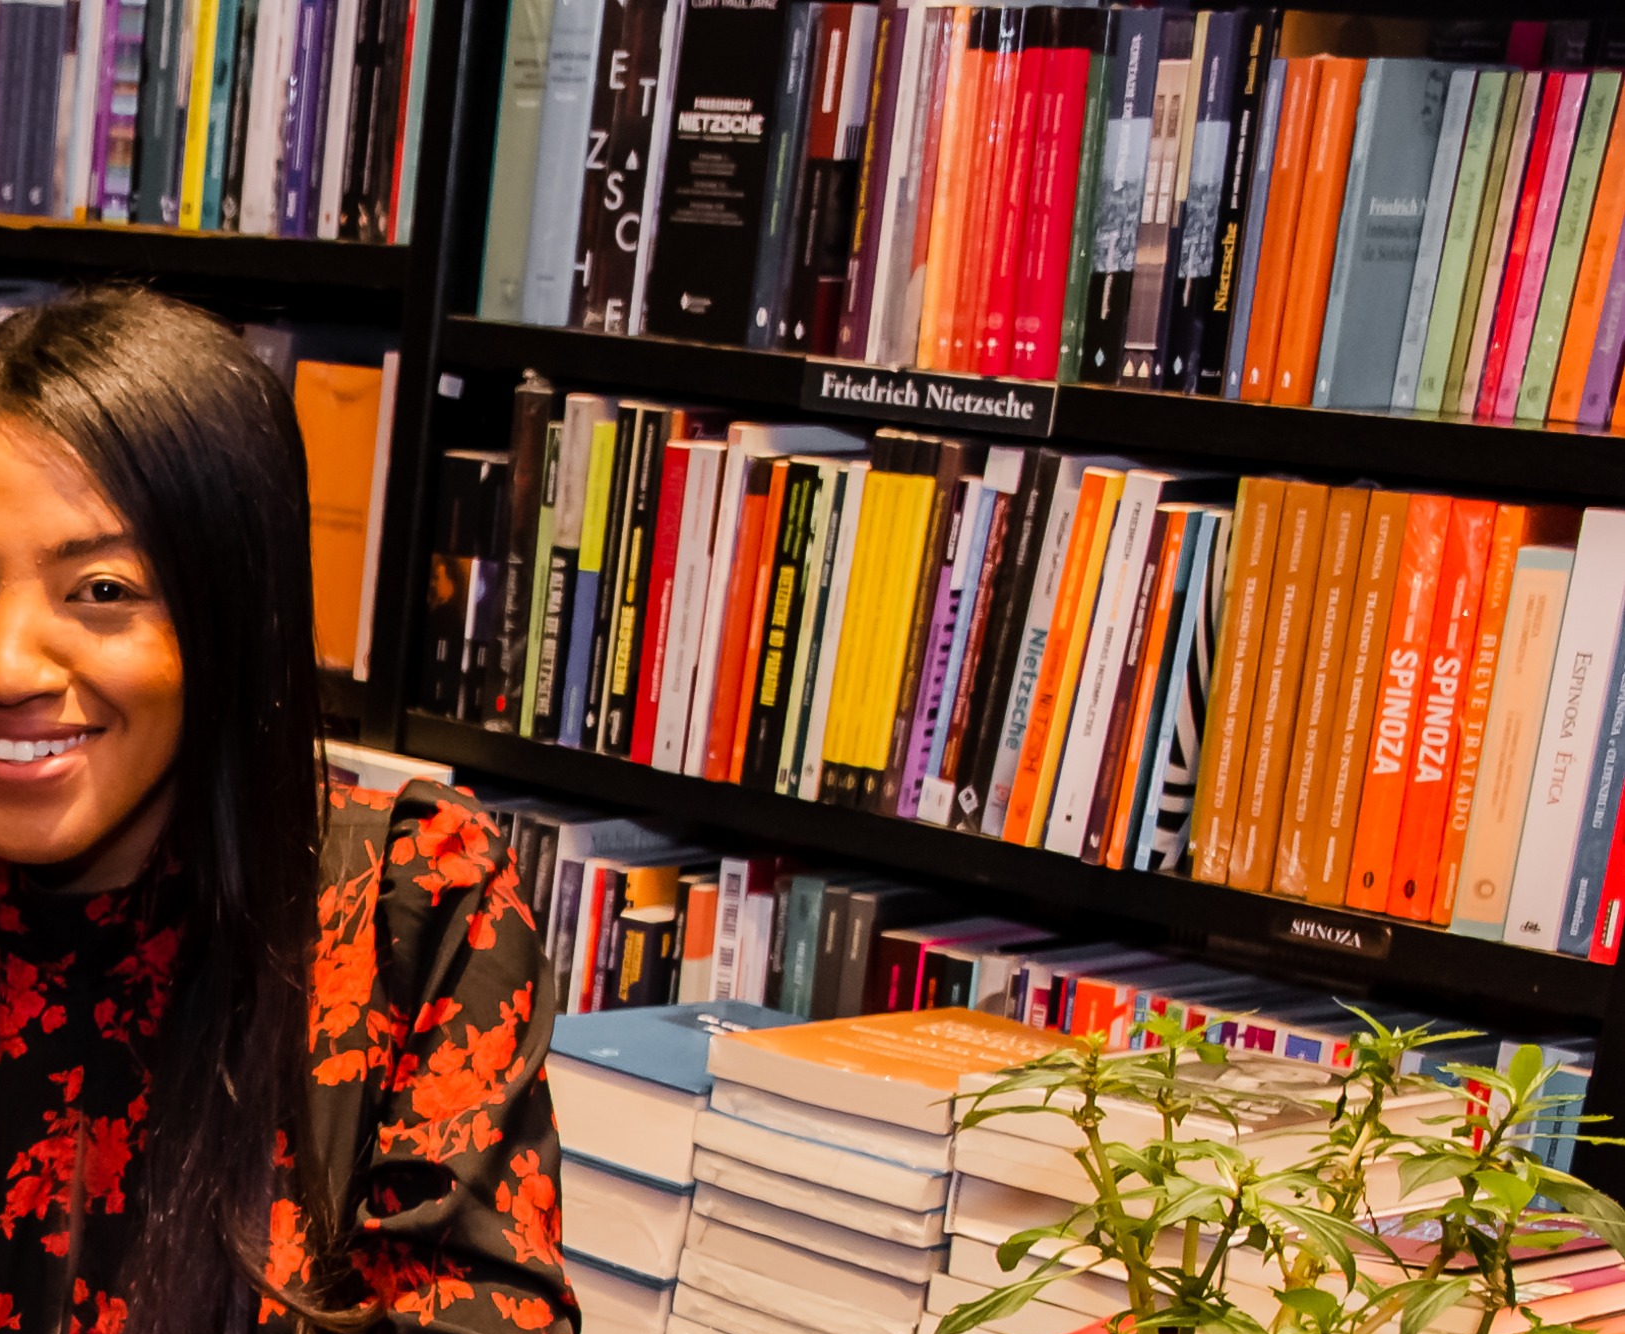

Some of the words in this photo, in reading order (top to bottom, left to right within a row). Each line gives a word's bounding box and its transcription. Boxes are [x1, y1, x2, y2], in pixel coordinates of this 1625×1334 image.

[678, 110, 765, 136] NIETZSCHE
[1208, 220, 1243, 313] Nietzsche
[821, 371, 919, 406] Friedrich
[925, 383, 1034, 421] Nietzsche
[1319, 586, 1339, 650] TRATADO
[1357, 590, 1377, 654] TRATADO
[1003, 626, 1047, 751] Nietzsche
[1316, 650, 1329, 670] DA
[1354, 654, 1367, 675] DA
[1470, 633, 1496, 710] BREVE
[1345, 677, 1363, 732] EMENDA
[1371, 648, 1418, 778] SPINOZA
[1413, 654, 1461, 786] SPINOZA
[1558, 650, 1593, 742] ESPINOSA
[1303, 728, 1316, 748] DO
[1341, 733, 1354, 754] DO
[1330, 755, 1351, 828] INTELECTO
[1451, 719, 1483, 831] TRATADO
[1545, 750, 1577, 807] ÉTICA
[1290, 915, 1362, 950] SPINOZA
